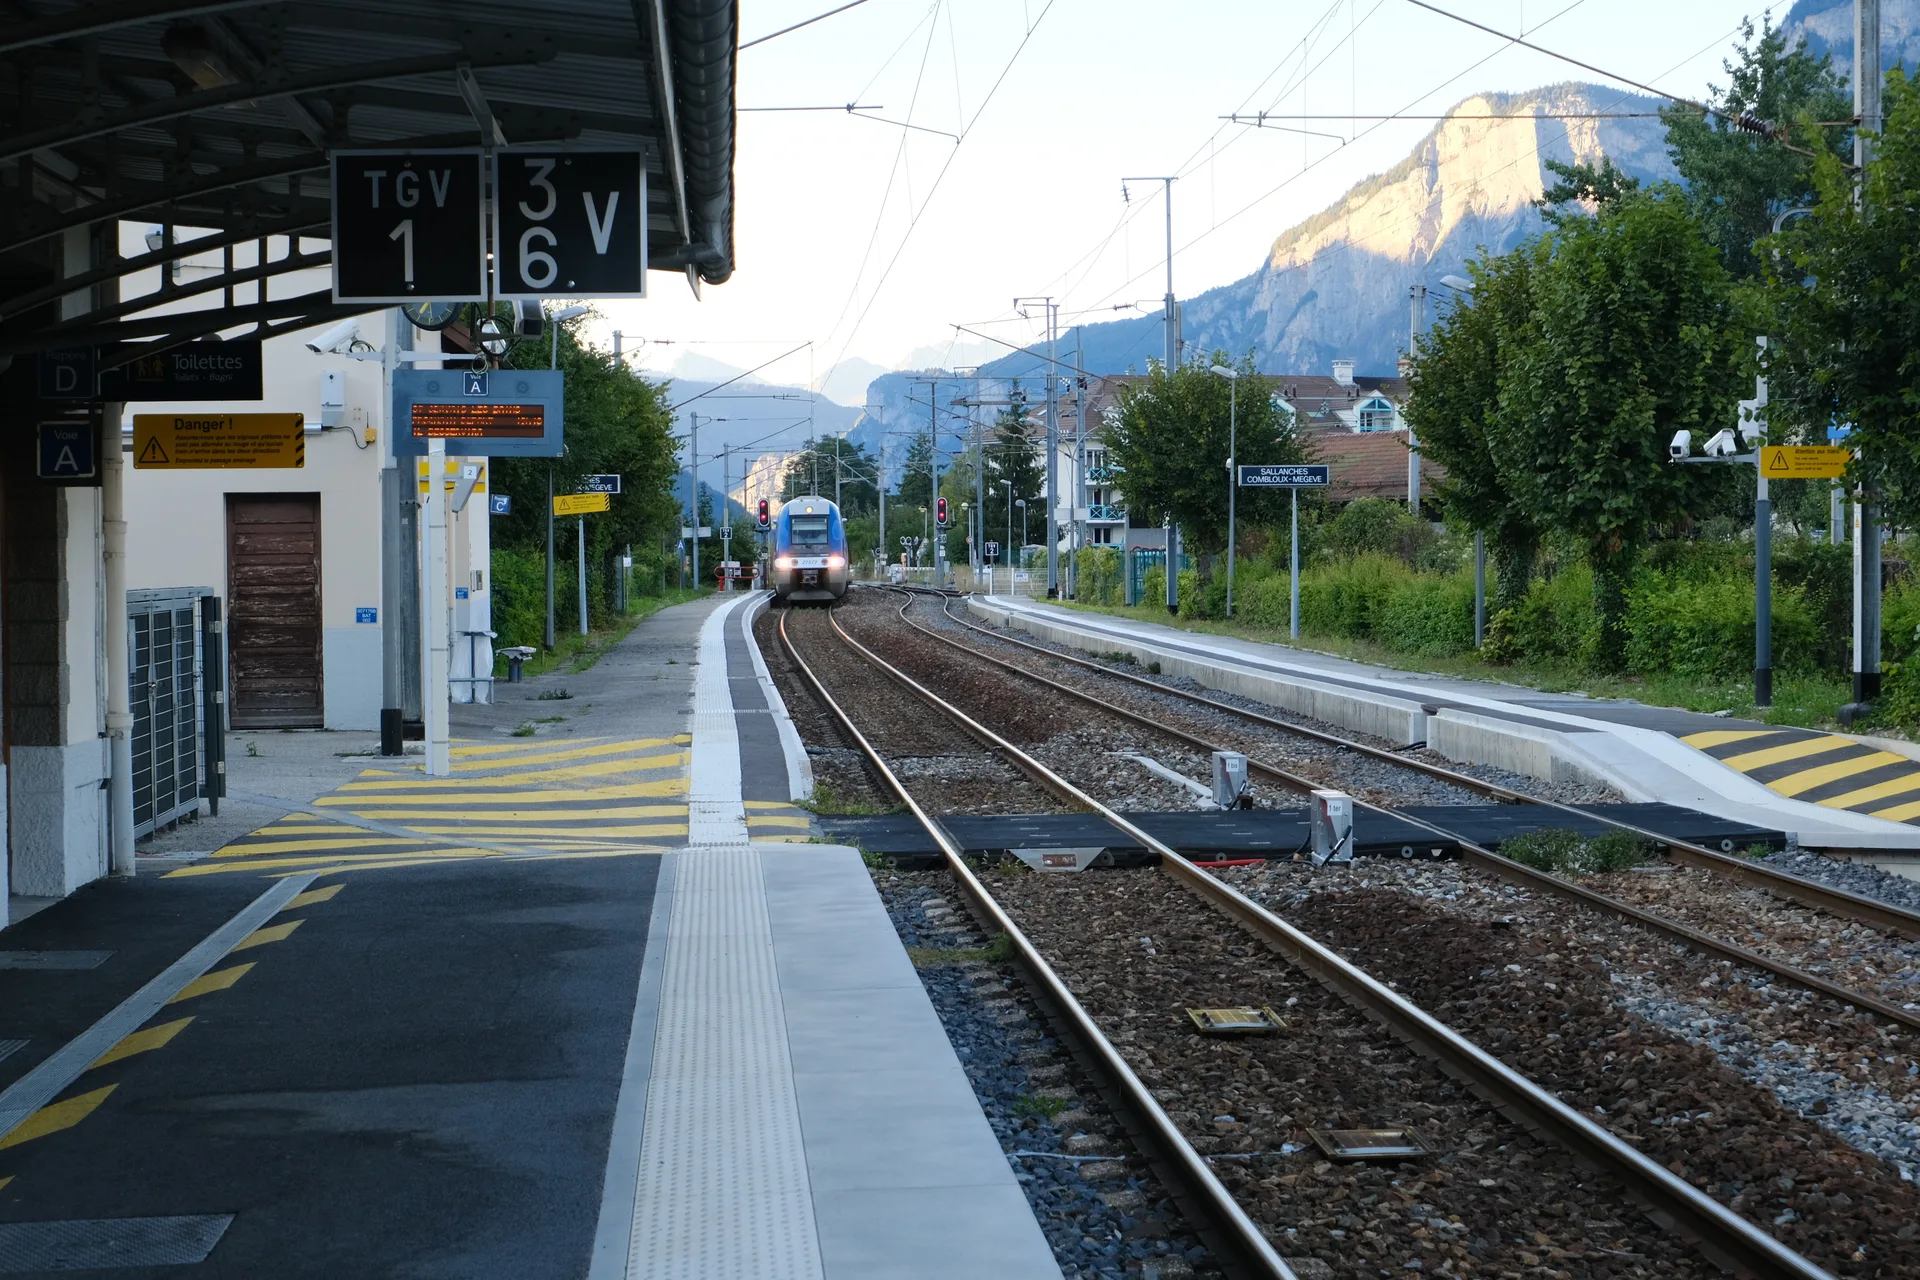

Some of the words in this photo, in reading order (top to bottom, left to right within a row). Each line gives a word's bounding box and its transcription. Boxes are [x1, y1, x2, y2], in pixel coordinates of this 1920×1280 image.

[363, 169, 452, 209] TGV
[518, 157, 557, 221] 3
[582, 190, 620, 255] V
[388, 218, 414, 283] 1
[518, 225, 558, 289] 6
[171, 353, 244, 371] Toilettes
[55, 365, 78, 392] D
[208, 371, 233, 383] Bagni
[470, 381, 481, 393] A
[53, 429, 78, 440] Voie
[173, 418, 225, 433] Danger
[53, 444, 79, 473] A
[1260, 468, 1309, 476] SALLANCHES
[496, 501, 505, 512] C
[1333, 804, 1341, 812] ter
